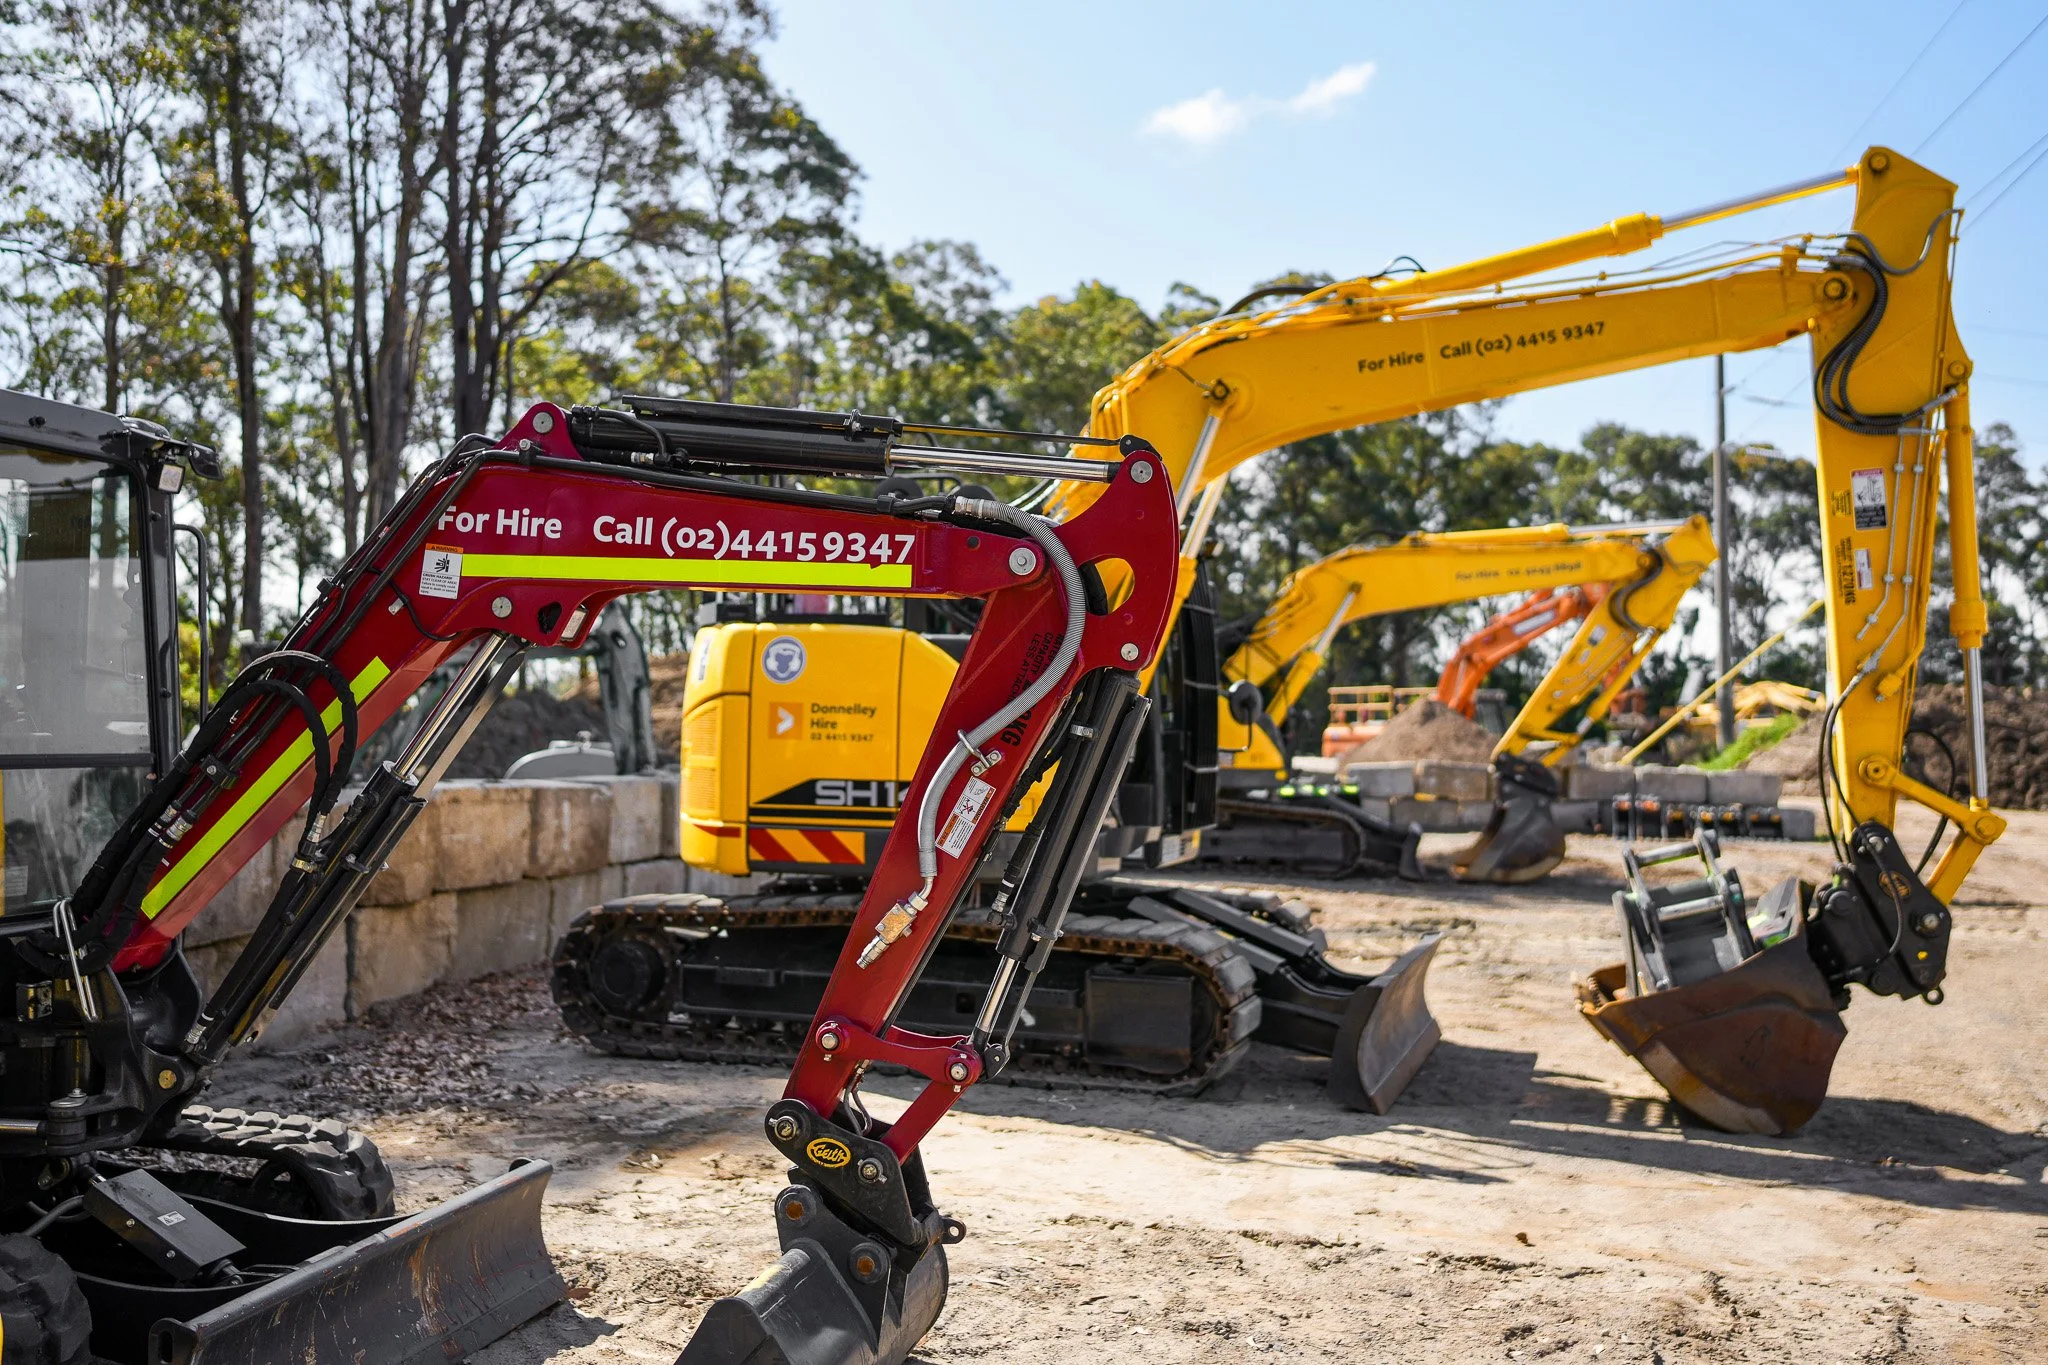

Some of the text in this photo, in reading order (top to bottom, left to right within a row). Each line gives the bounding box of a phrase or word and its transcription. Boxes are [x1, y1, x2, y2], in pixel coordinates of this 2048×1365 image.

[1358, 321, 1604, 373] For Hire Call (02) 4415 9347
[438, 505, 490, 534] For
[496, 508, 562, 539] Hire
[593, 515, 654, 545] Call
[1026, 633, 1041, 658] LESS
[1031, 632, 1054, 675] CAPACITY
[810, 702, 877, 718] Donnelley
[810, 716, 838, 729] Hire
